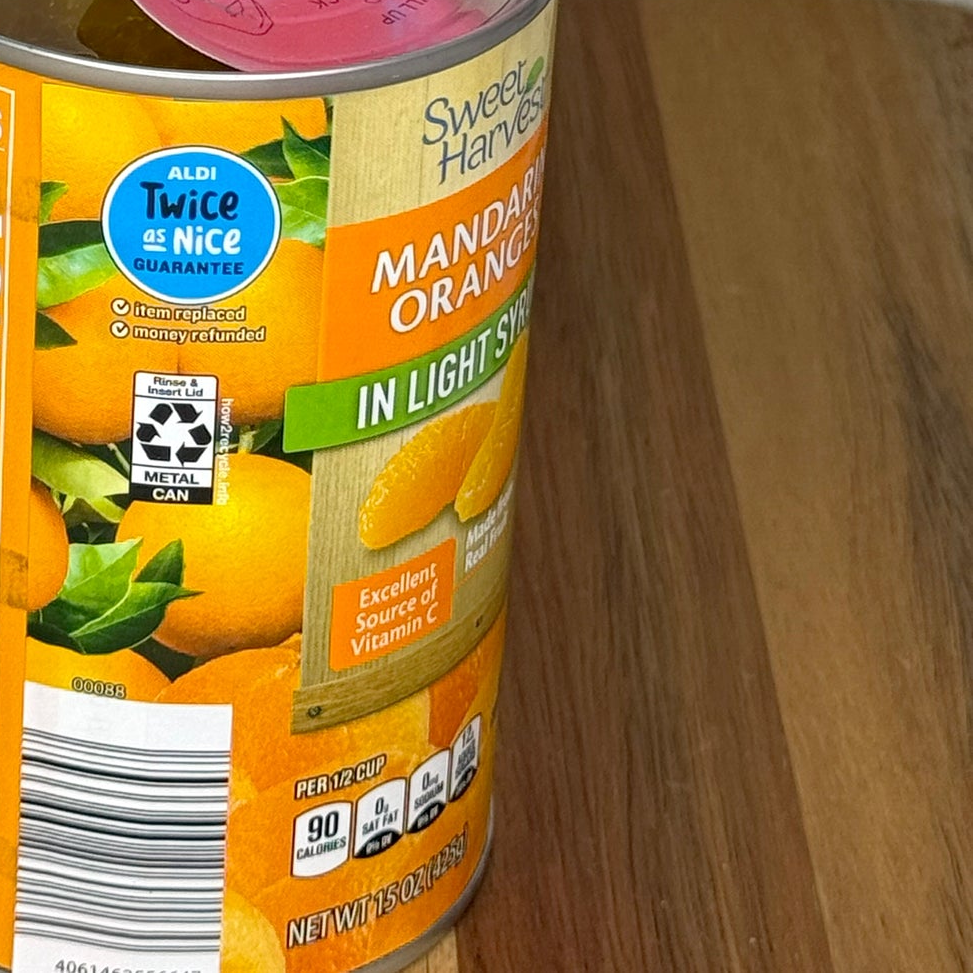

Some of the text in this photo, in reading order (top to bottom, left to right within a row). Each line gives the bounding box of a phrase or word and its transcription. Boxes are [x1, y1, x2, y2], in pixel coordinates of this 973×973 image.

[382, 9, 407, 26] UP
[421, 59, 527, 146] Sweet
[166, 166, 217, 181] ALDI
[139, 181, 240, 222] Twice
[142, 225, 242, 257] as Nice
[133, 257, 245, 276] GUARANTEE
[133, 302, 247, 325] item replaced
[132, 326, 267, 345] money refunded
[147, 385, 204, 398] Insert Lid
[153, 376, 199, 388] Rinse &
[357, 377, 397, 430] IN
[406, 328, 492, 414] LIGHT
[143, 470, 200, 485] METAL
[151, 487, 190, 502] CAN
[359, 562, 438, 610] Excellent
[355, 577, 439, 634] Source of
[349, 601, 440, 657] Vitamin C
[72, 677, 126, 699] 00088
[295, 753, 387, 801] PER 1/2 CUP
[307, 810, 340, 844] 90
[361, 807, 400, 837] SAT FAT
[295, 834, 348, 862] CALORIES
[287, 910, 332, 950] NET
[333, 895, 371, 933] WT
[373, 882, 399, 920] 15
[397, 859, 427, 905] OZ
